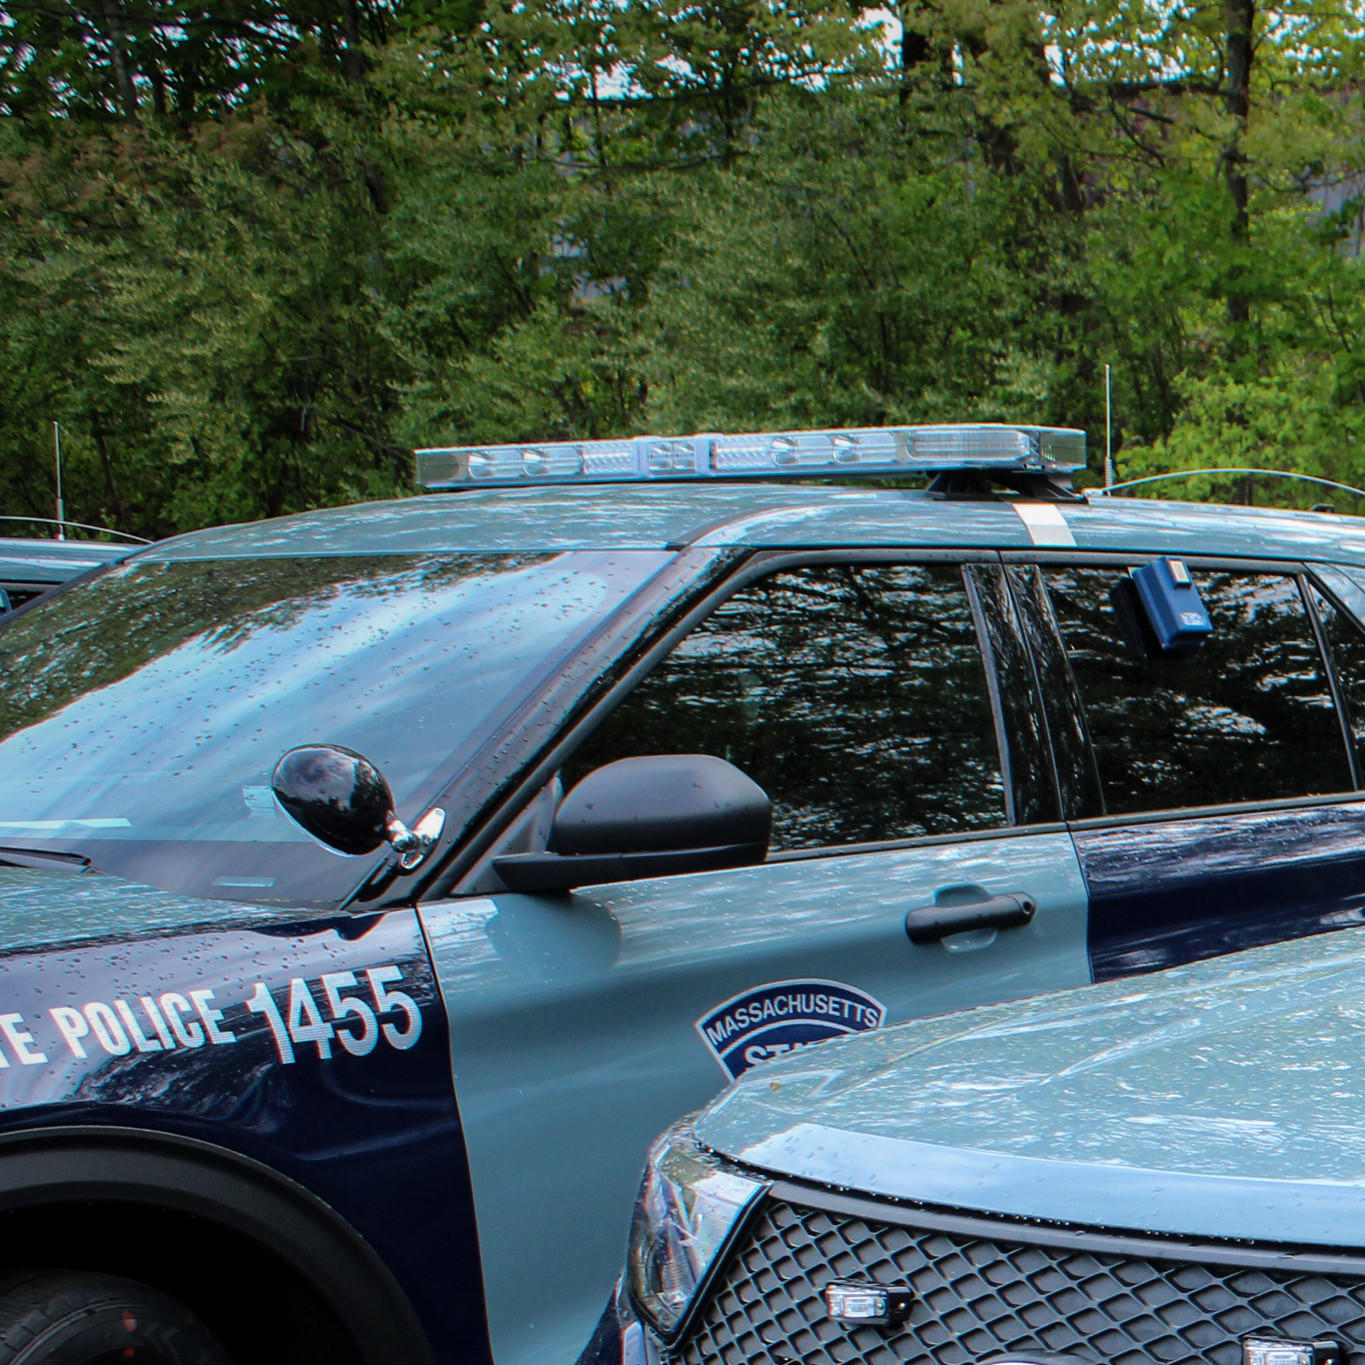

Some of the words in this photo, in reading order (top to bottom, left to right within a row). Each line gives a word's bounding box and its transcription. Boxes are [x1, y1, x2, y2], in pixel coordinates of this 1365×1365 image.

[0, 1012, 49, 1068] E
[47, 989, 237, 1059] POLICE
[246, 965, 423, 1065] 1455
[706, 993, 879, 1045] MASSACHUSETTS
